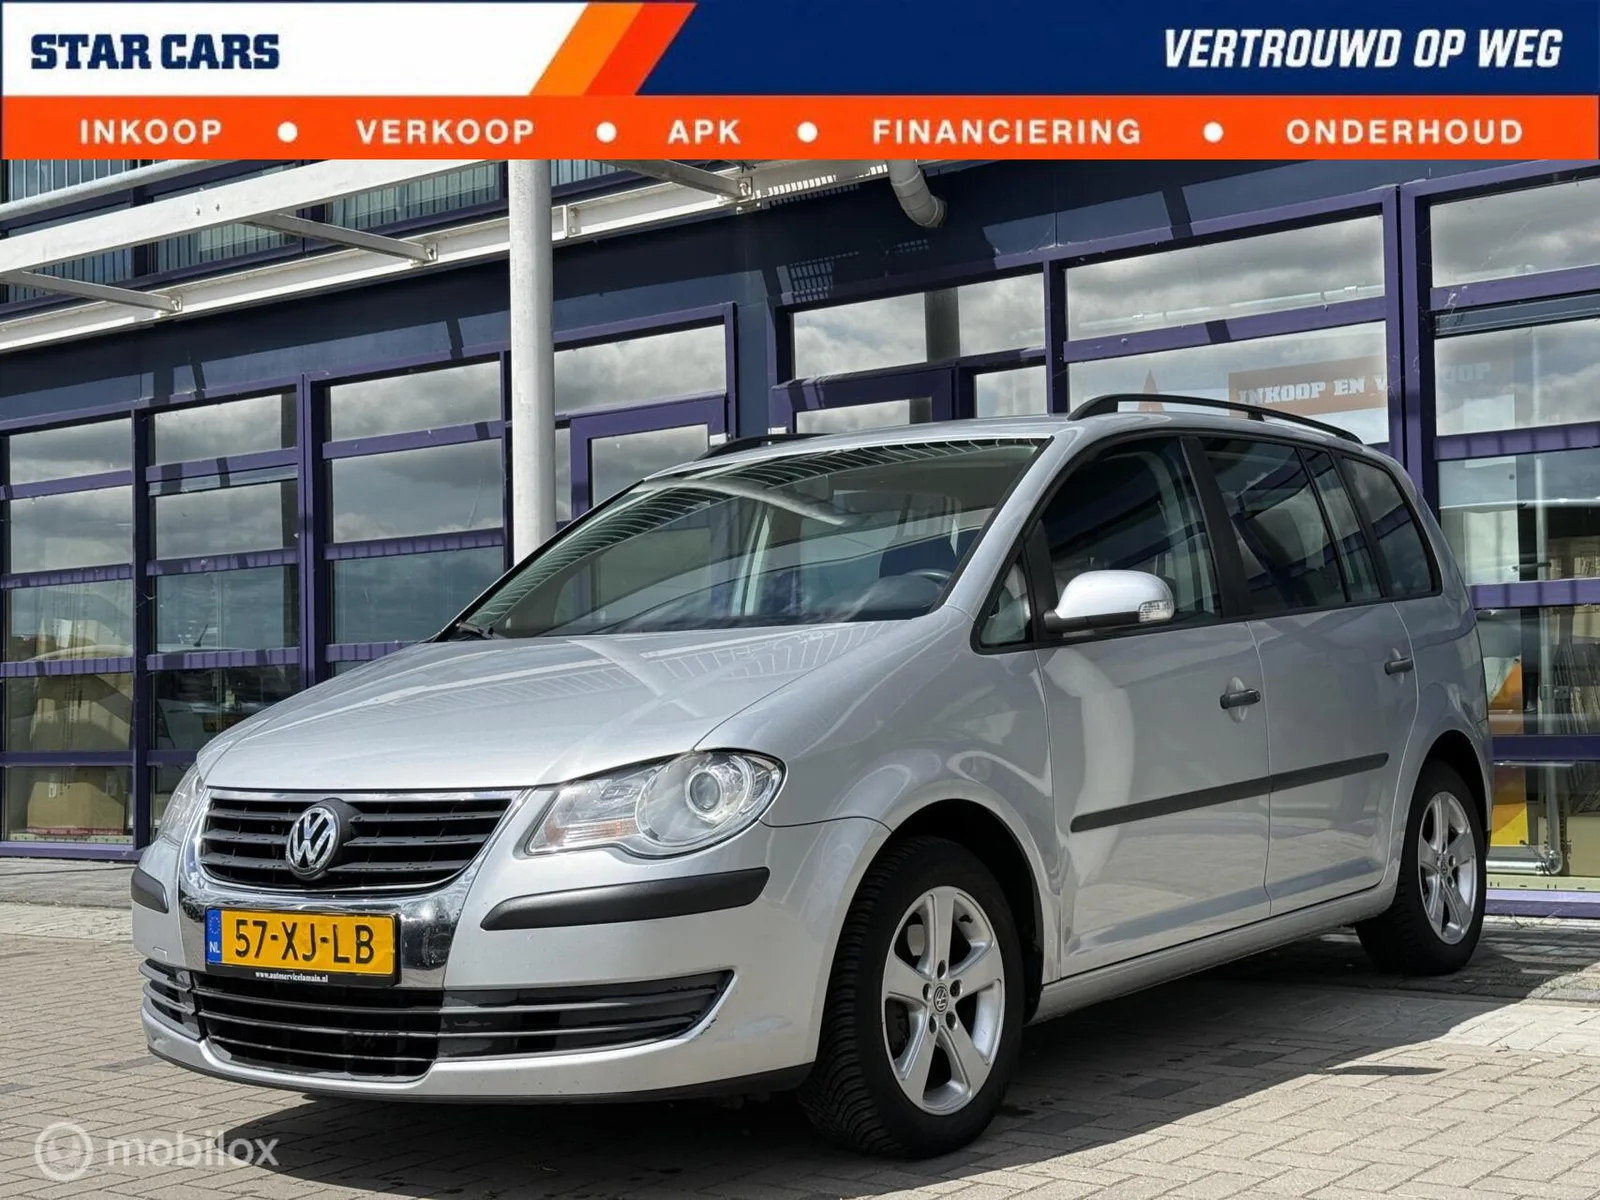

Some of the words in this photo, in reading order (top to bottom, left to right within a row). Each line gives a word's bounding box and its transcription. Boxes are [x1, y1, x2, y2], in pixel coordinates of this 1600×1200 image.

[1237, 381, 1327, 405] INKOOP
[1333, 377, 1366, 396] EN
[209, 940, 221, 955] NL
[234, 919, 375, 965] 57-XJ-LB
